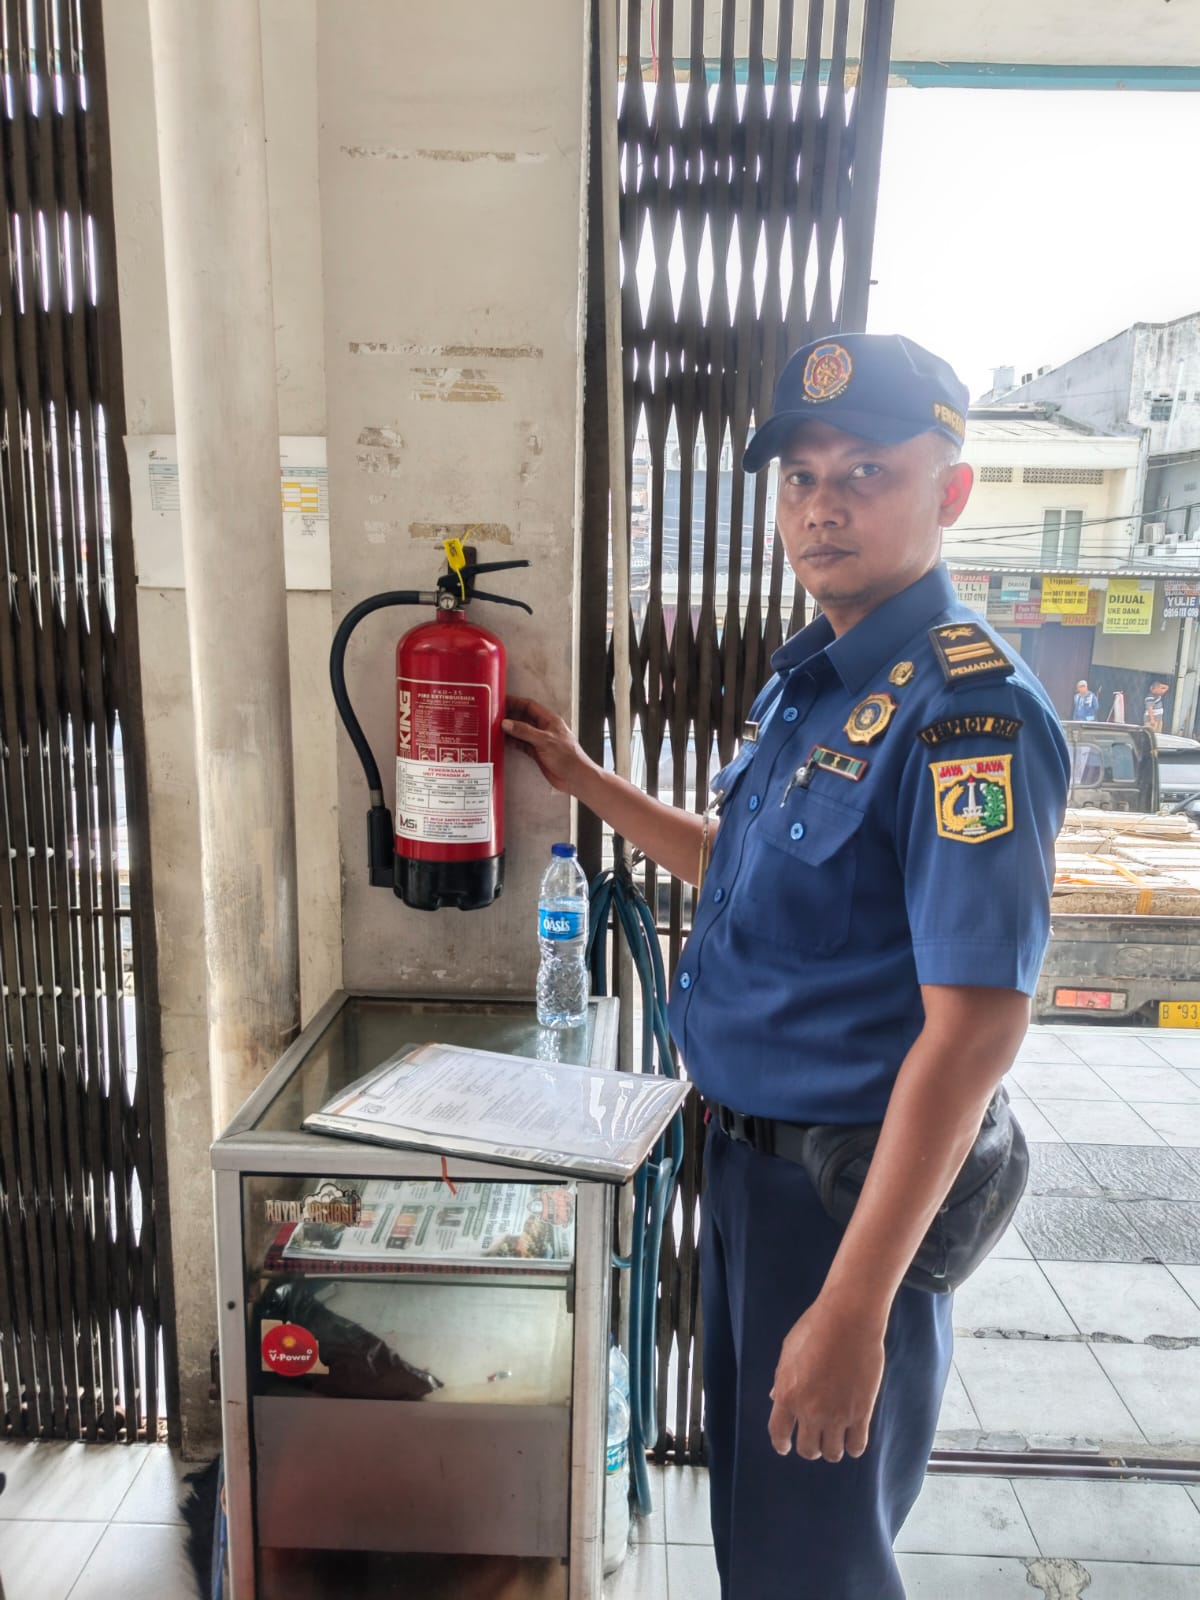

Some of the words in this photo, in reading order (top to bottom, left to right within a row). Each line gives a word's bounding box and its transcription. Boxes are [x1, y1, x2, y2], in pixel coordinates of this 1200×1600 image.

[1109, 595, 1145, 604] DIJUAL
[1167, 596, 1196, 607] YULIE
[949, 658, 1005, 677] PEMADAM
[399, 690, 412, 750] KING
[939, 764, 963, 779] JAYA
[976, 760, 1005, 774] RAYA
[1162, 1004, 1169, 1019] B
[264, 1200, 304, 1222] ROYAL
[269, 1353, 312, 1361] V-Power
